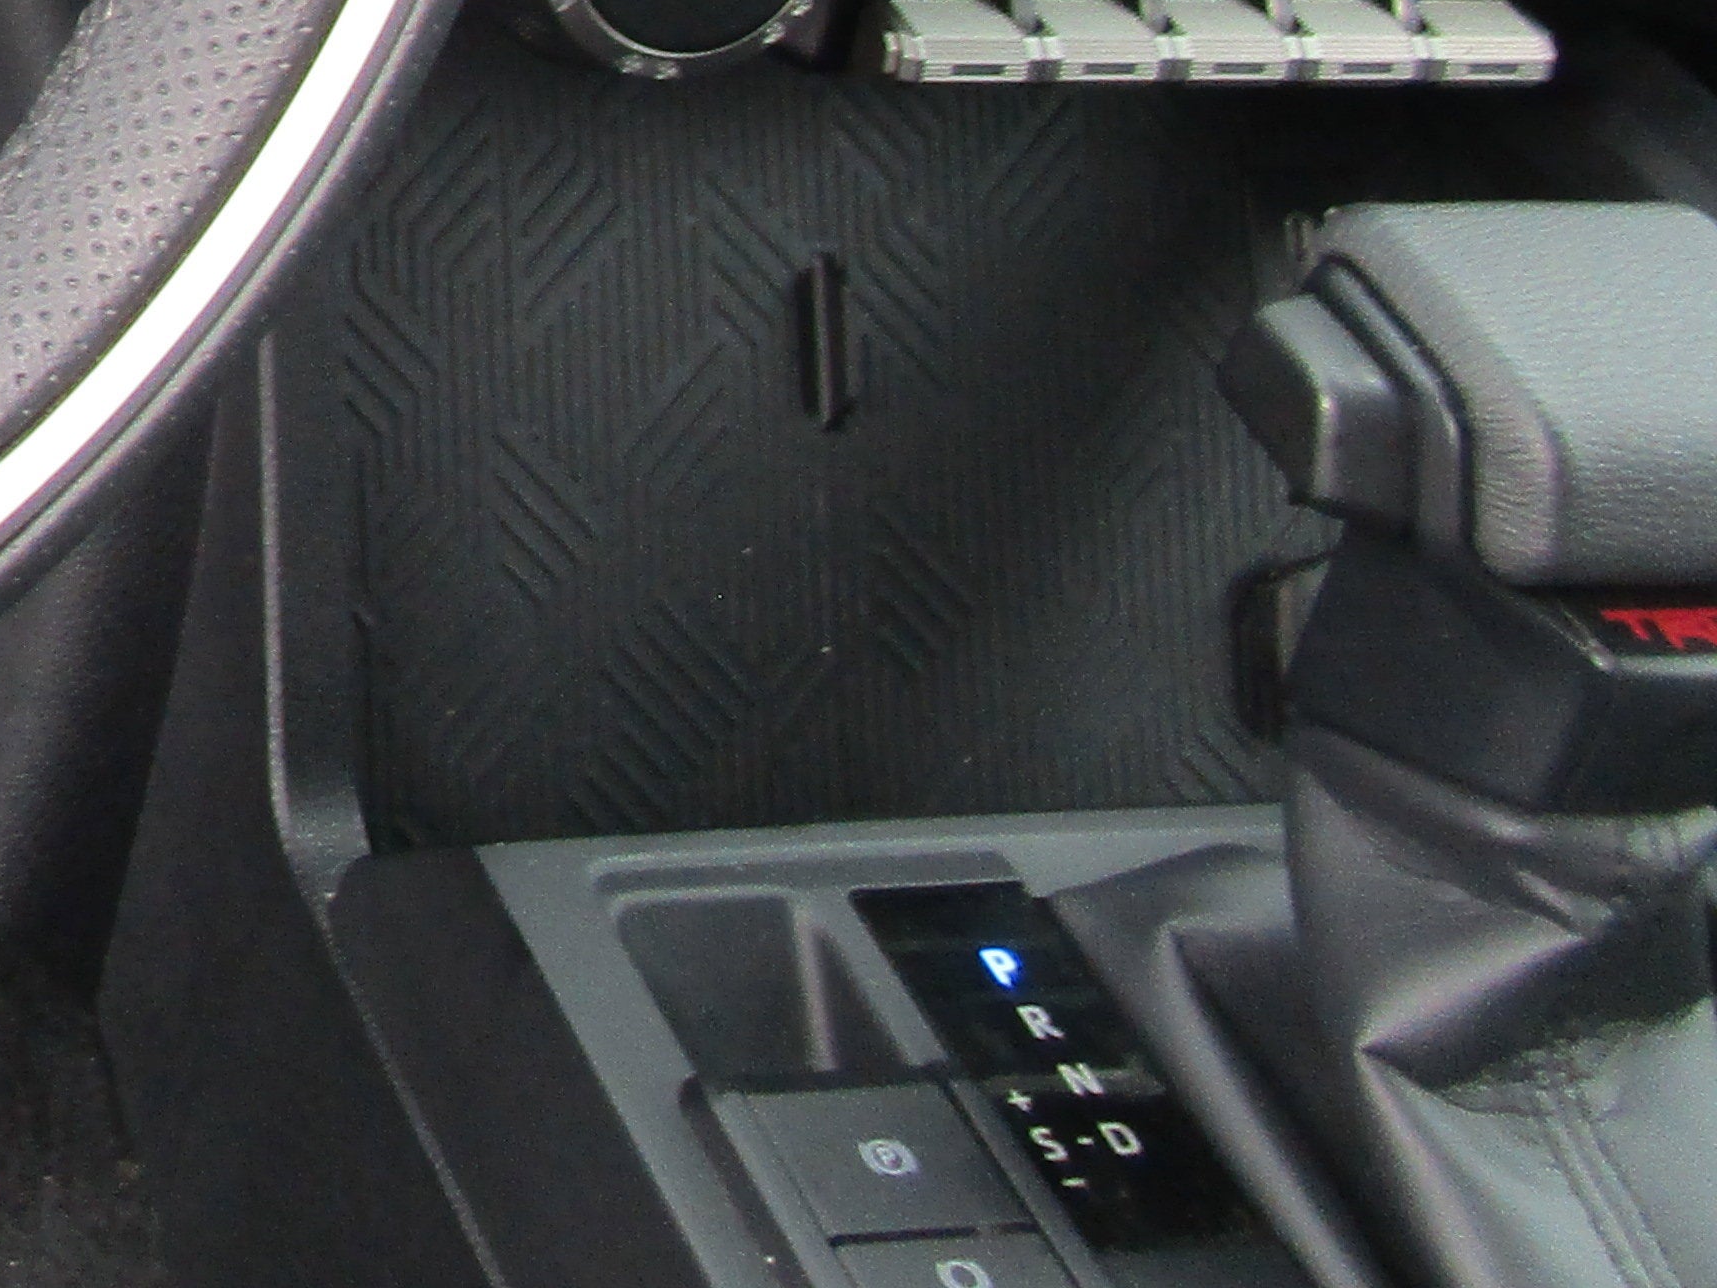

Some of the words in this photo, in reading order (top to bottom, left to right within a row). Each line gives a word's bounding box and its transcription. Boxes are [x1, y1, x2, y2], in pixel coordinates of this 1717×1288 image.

[977, 946, 1023, 989] P
[1016, 1002, 1065, 1041] R
[1056, 1061, 1104, 1097] N
